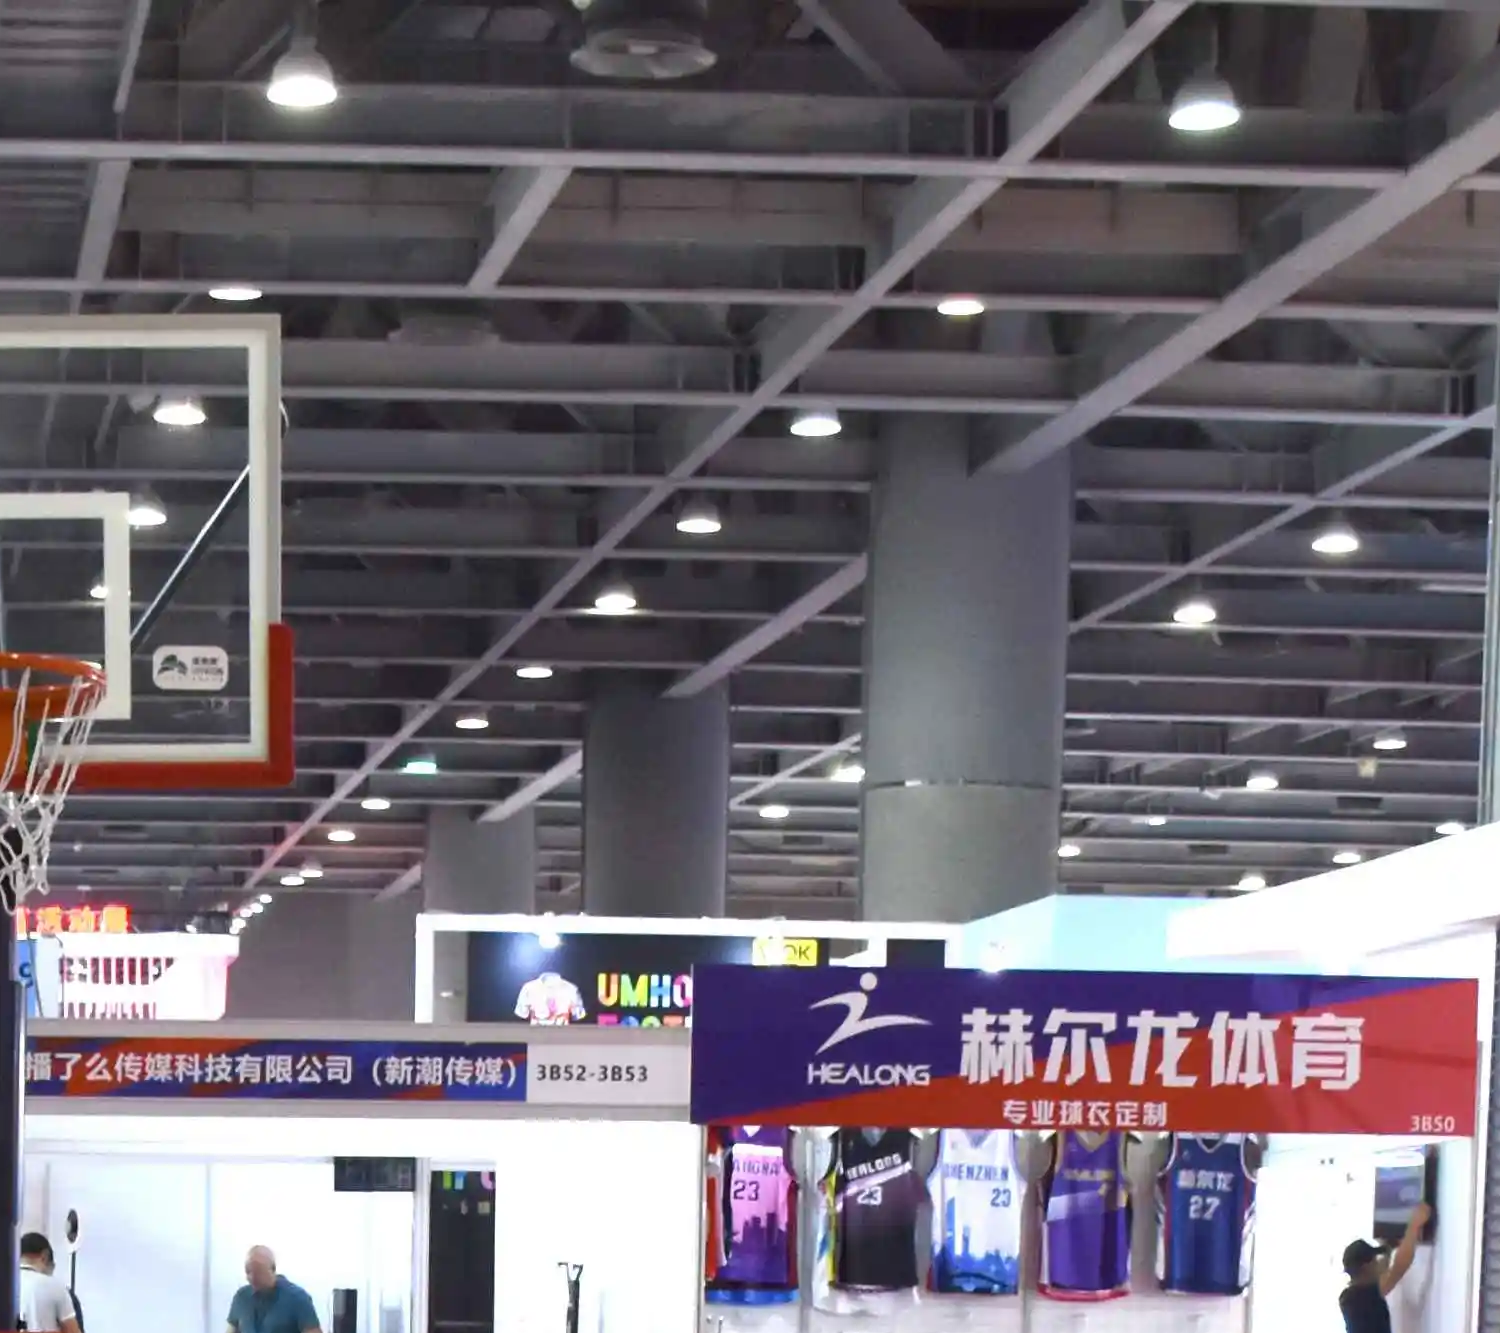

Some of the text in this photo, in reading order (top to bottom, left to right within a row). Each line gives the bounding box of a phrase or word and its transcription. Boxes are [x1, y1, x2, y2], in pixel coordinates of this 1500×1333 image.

[959, 1008, 1366, 1092] 赫尔龙体育
[536, 1064, 649, 1084] 3B52-3B53
[807, 1063, 930, 1087] HEALONG
[1002, 1099, 1168, 1128] 专业球衣定制
[1410, 1114, 1456, 1133] 3B50
[733, 1179, 760, 1201] 23
[990, 1187, 1011, 1207] 23
[1188, 1195, 1220, 1220] 27
